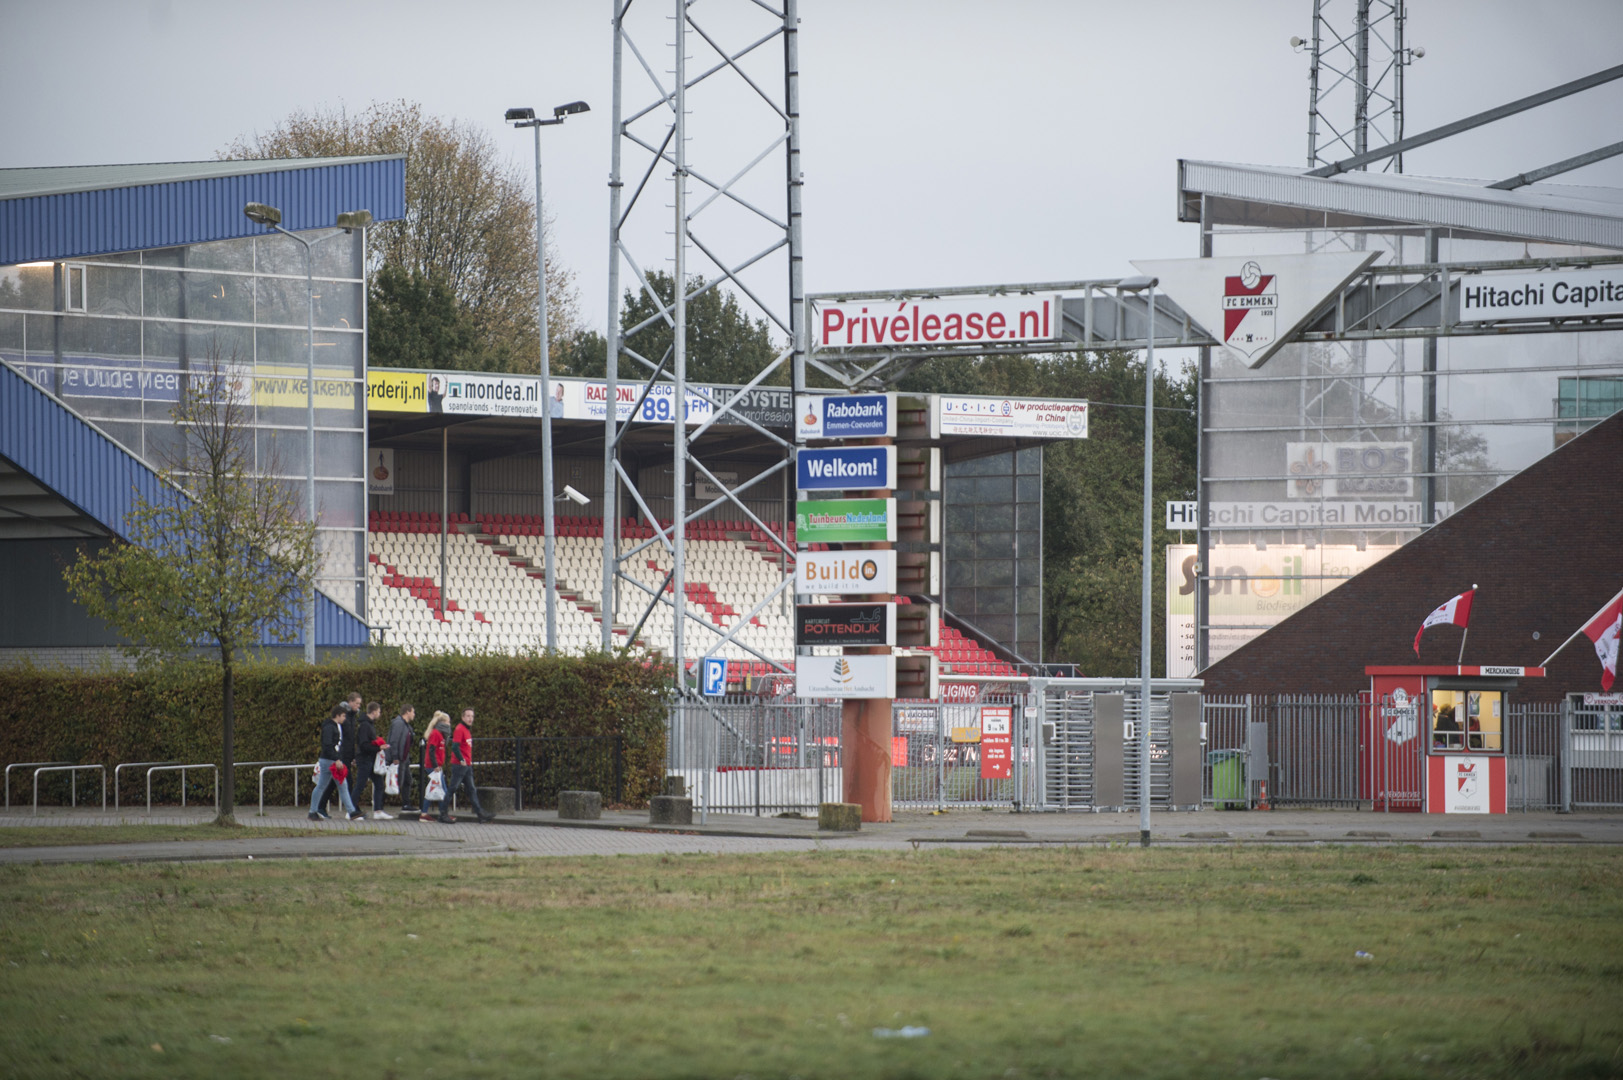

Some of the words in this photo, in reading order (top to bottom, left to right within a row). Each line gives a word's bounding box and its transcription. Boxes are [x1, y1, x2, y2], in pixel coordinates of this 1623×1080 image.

[1226, 298, 1237, 307] FC
[1240, 296, 1274, 307] EMMEN
[1465, 283, 1544, 308] Hitachi
[822, 301, 1049, 345] Privélease.nl
[465, 379, 539, 402] mondea.nl
[586, 386, 635, 402] RADONL
[691, 399, 709, 413] FM
[740, 390, 793, 409] SYSTE
[1014, 401, 1026, 410] Uw
[1027, 403, 1087, 413] productiepartner
[494, 402, 538, 414] traprenovatie
[826, 401, 884, 418] Rabobank
[826, 420, 884, 430] Emmen-Coevorden
[1044, 413, 1066, 422] China
[807, 457, 878, 478] Welkom!
[1261, 503, 1346, 528] Capital
[804, 623, 880, 634] POTTENDIJK
[708, 661, 722, 691] P
